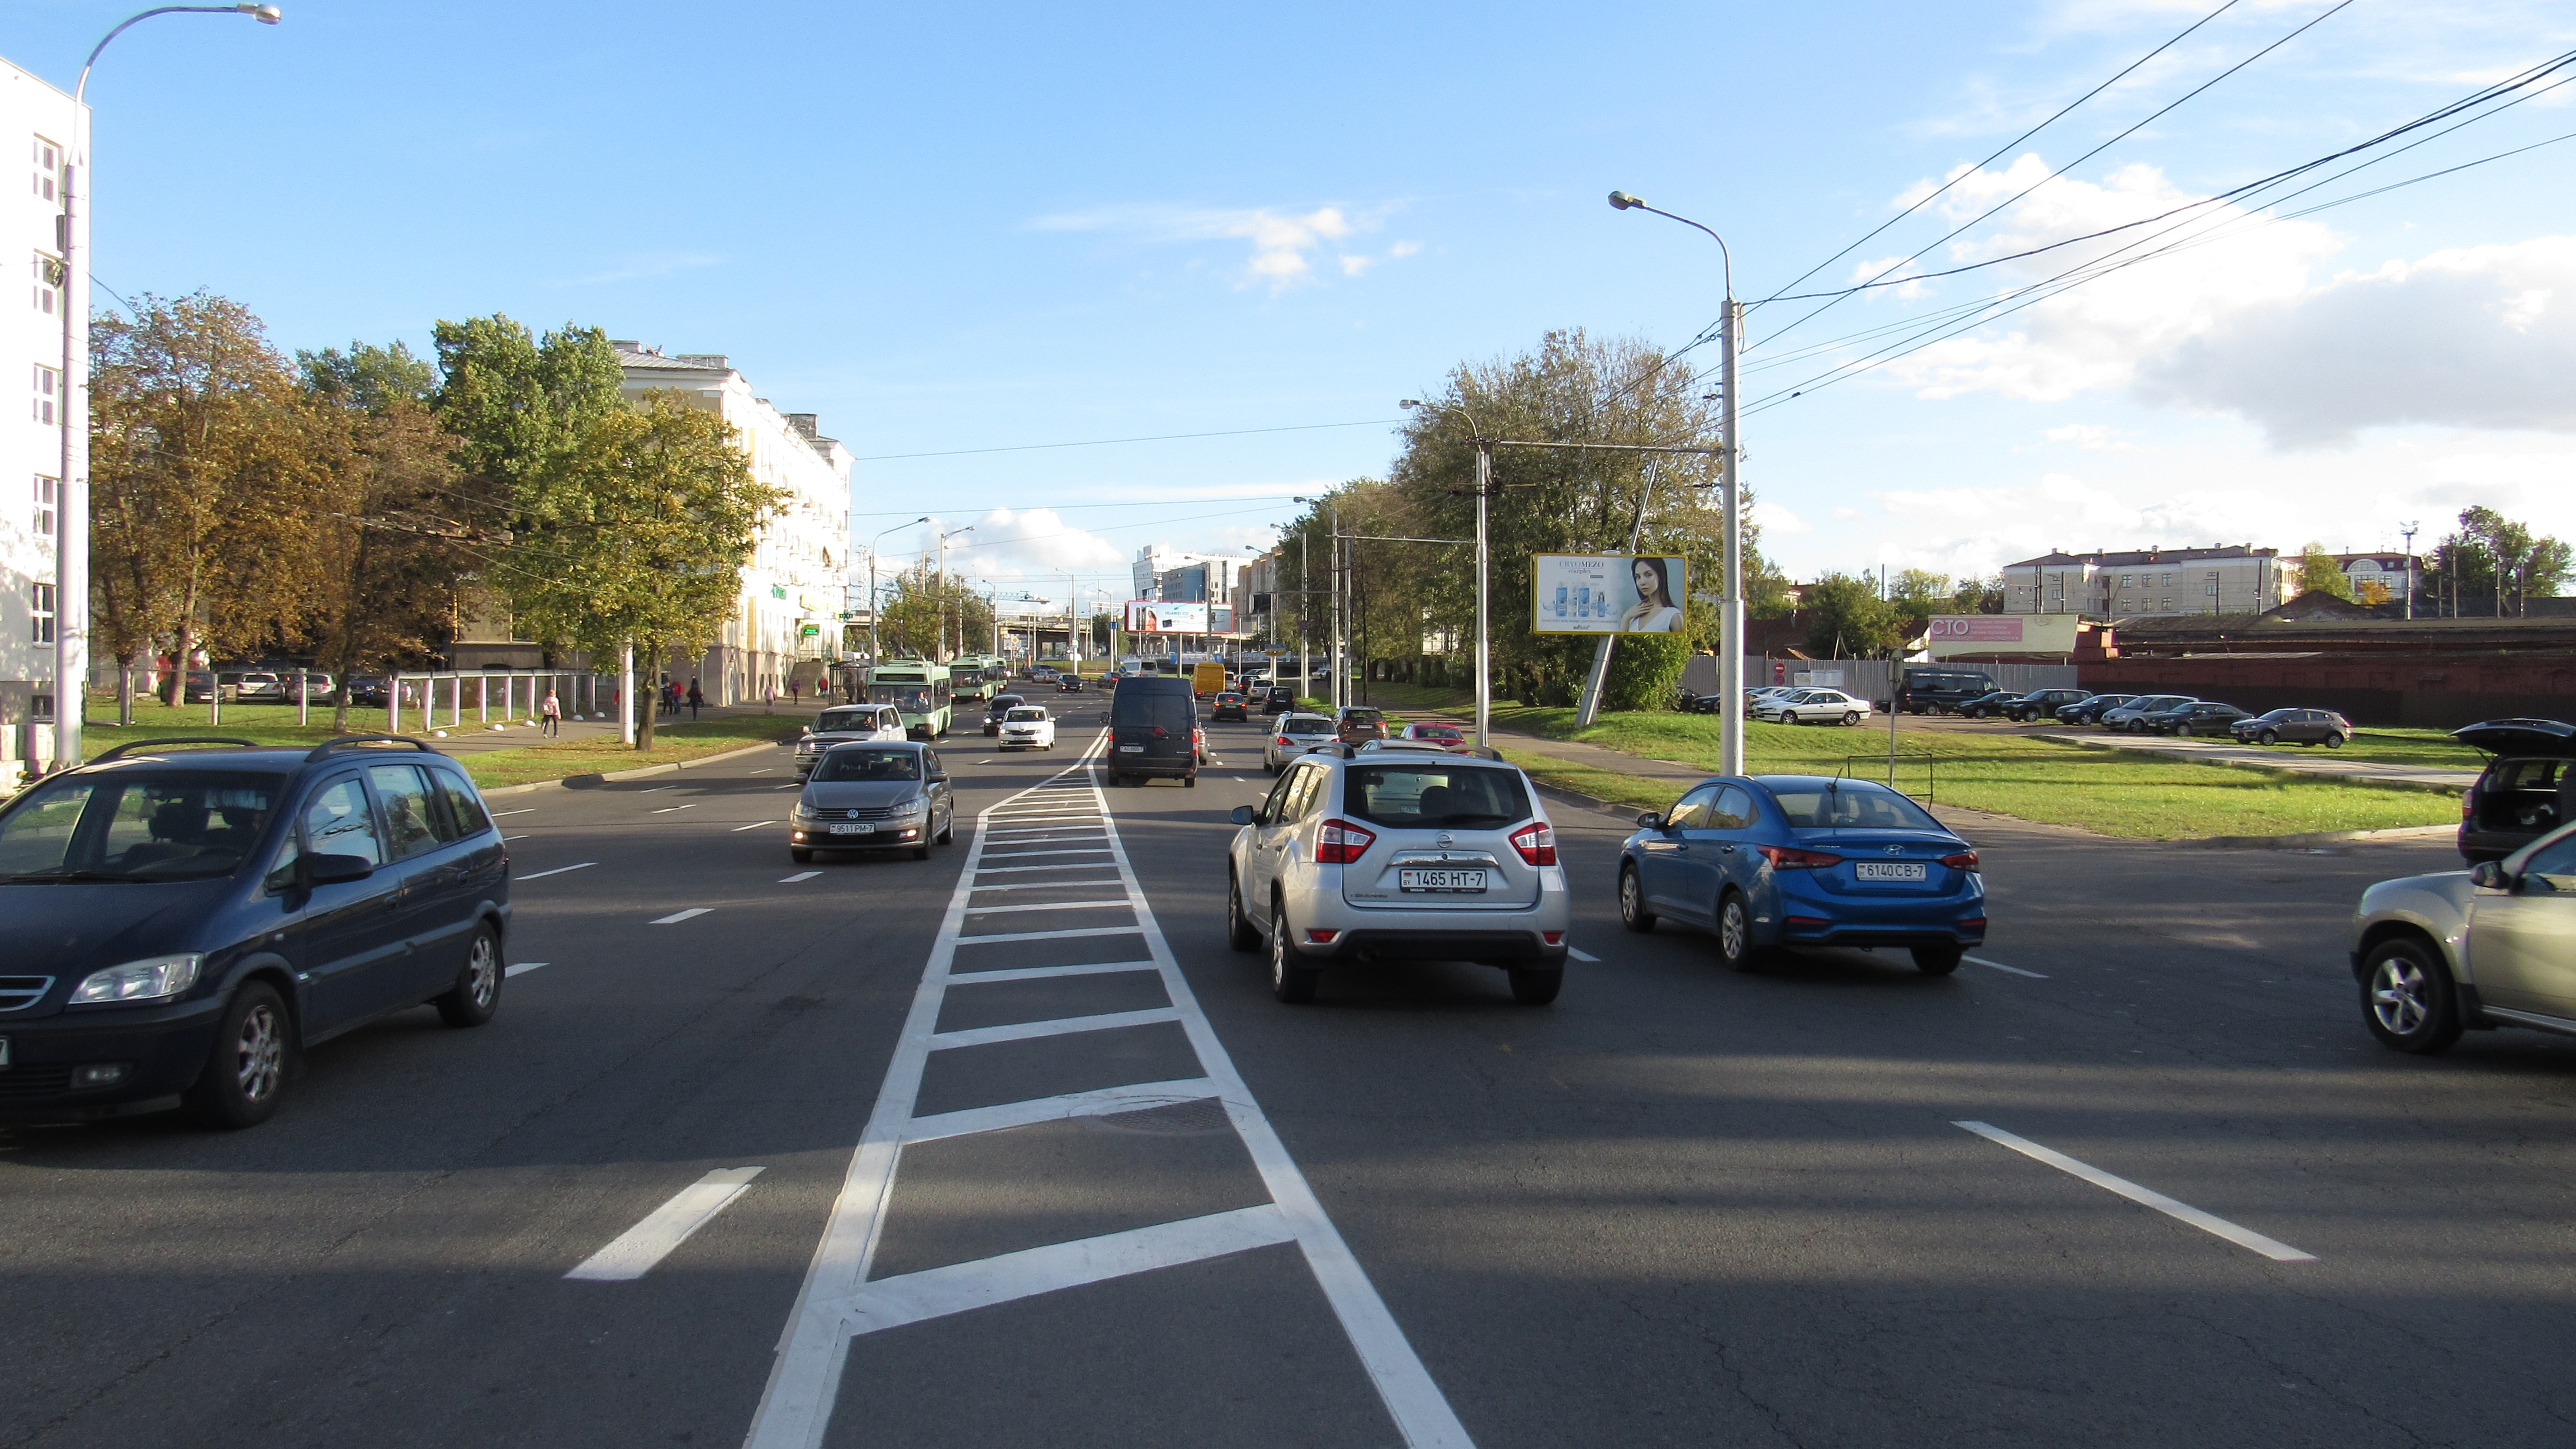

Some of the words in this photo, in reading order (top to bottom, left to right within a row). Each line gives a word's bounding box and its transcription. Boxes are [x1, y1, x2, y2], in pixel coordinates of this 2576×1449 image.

[1930, 619, 1969, 634] СТО
[1867, 864, 1893, 877] 6140
[1895, 865, 1924, 877] CB-7
[1416, 872, 1446, 886] 1465
[1451, 872, 1484, 886] HT-7
